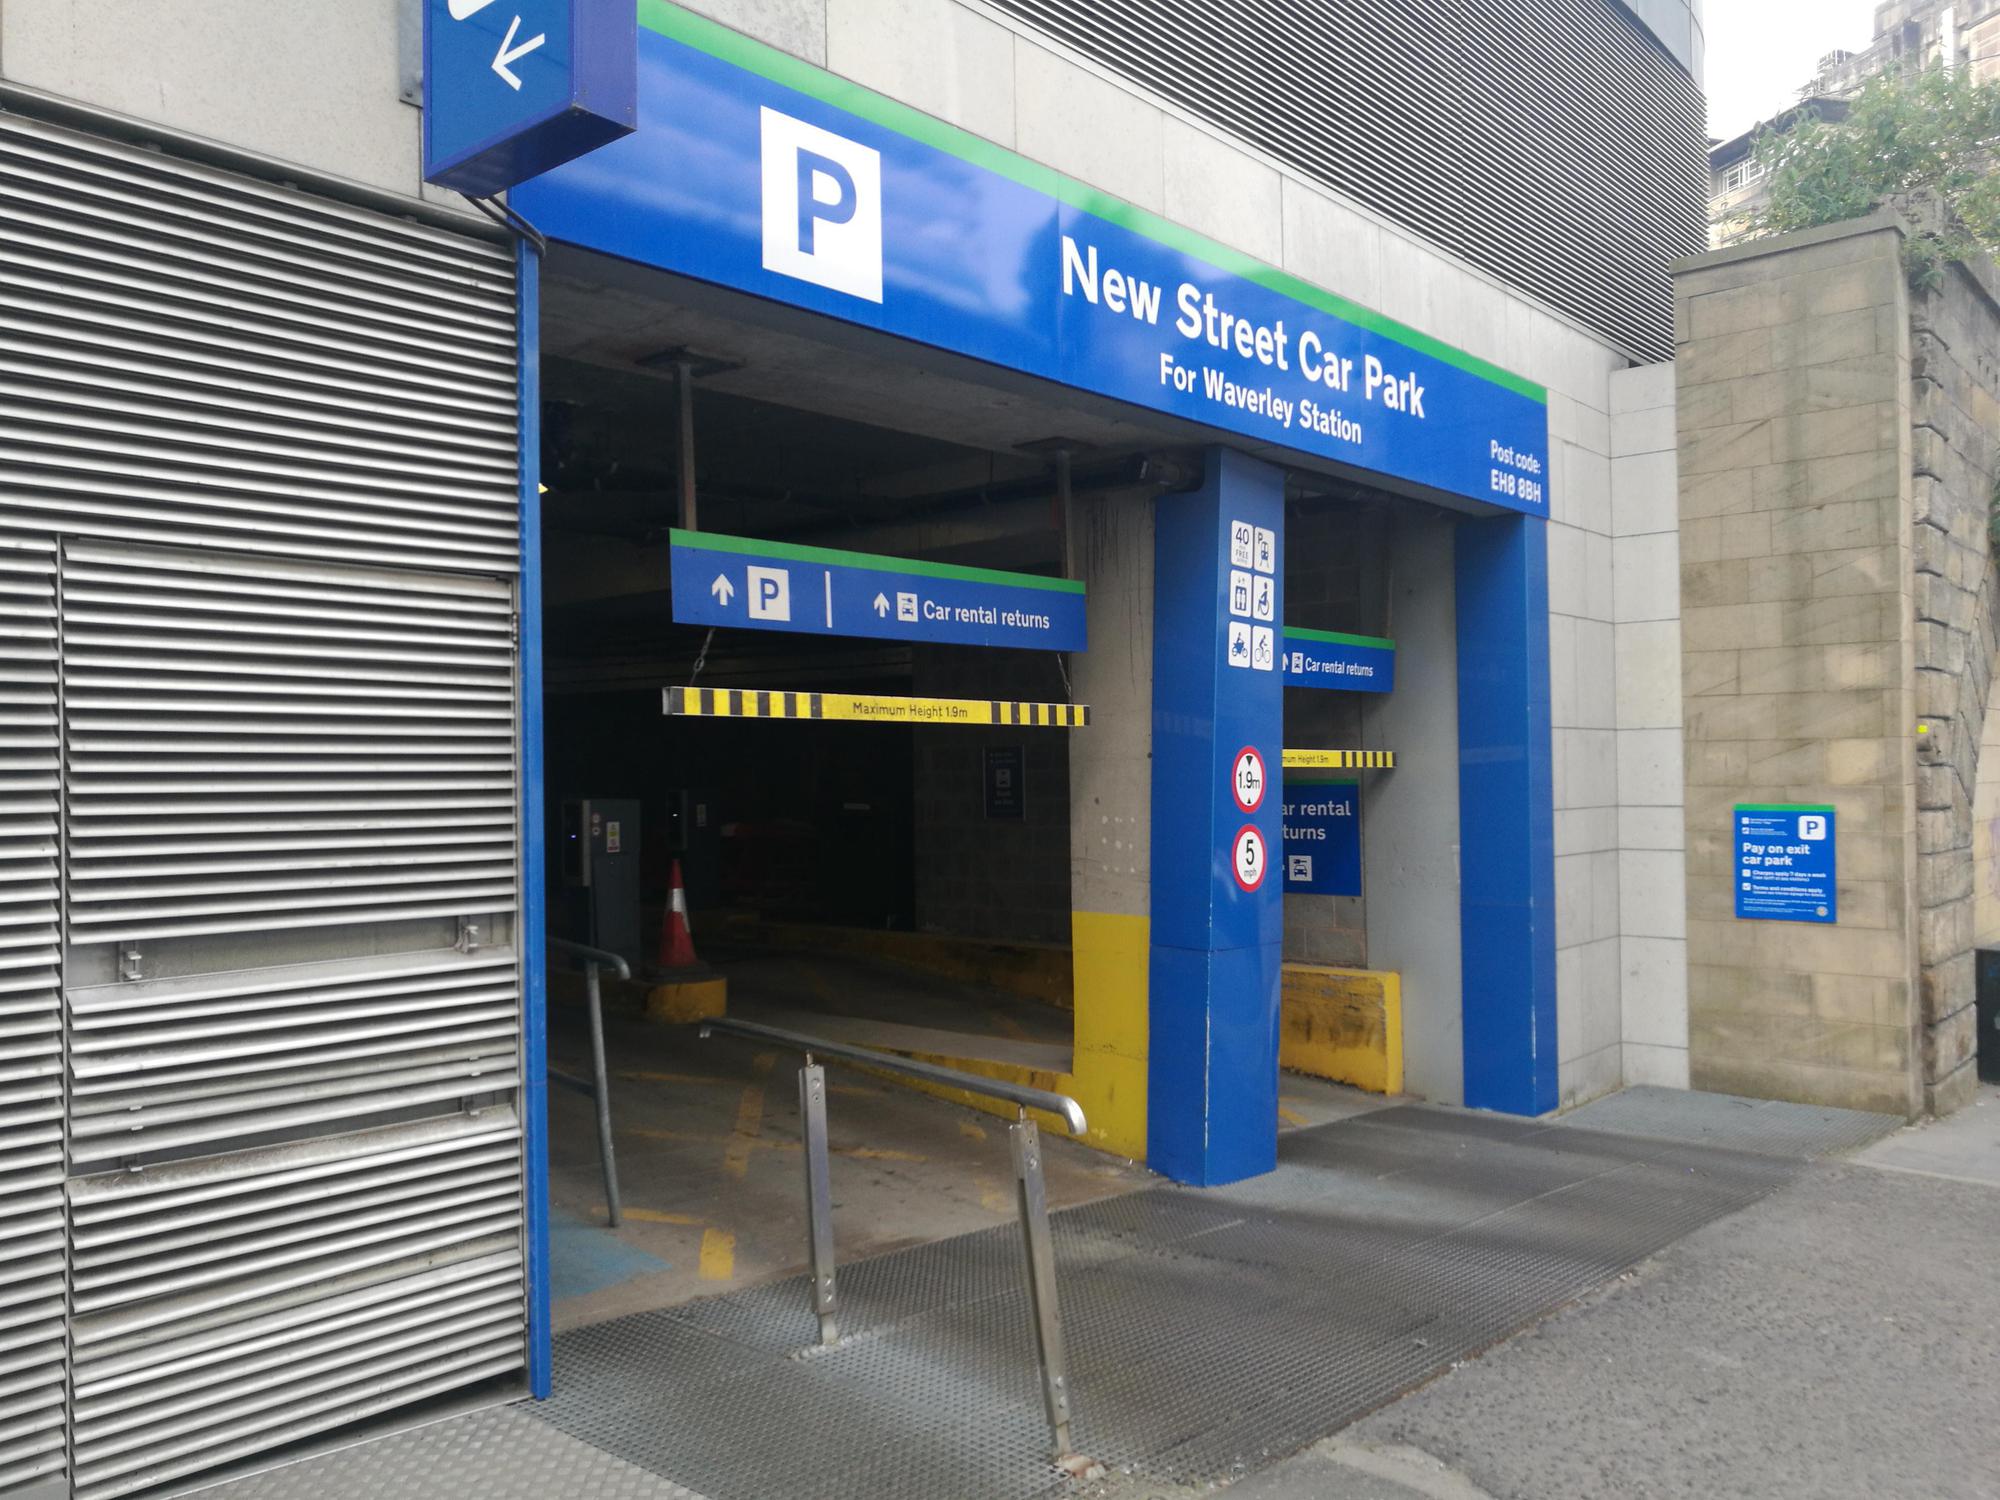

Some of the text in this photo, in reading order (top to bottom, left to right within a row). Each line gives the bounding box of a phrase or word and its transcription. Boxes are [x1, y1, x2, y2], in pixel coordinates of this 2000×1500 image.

[797, 147, 857, 256] P
[1062, 235, 1425, 418] New Street Car Park
[1160, 352, 1362, 444] For Waverley Station
[1491, 439, 1541, 474] Post code:
[1491, 469, 1541, 503] EH8 8BH
[1235, 527, 1249, 545] 40
[1257, 532, 1263, 545] P
[759, 578, 779, 611] P
[924, 600, 1050, 629] Car rental returns
[1305, 657, 1374, 677] Car rental returns
[853, 702, 968, 719] Maximum Height 1.9m
[1238, 771, 1260, 789] 1.9m
[1282, 800, 1351, 816] ar rental
[1283, 824, 1327, 841] turns
[1806, 820, 1818, 835] P
[1246, 839, 1254, 866] 5
[1743, 842, 1811, 855] Pay on exit
[1742, 855, 1793, 866] car park
